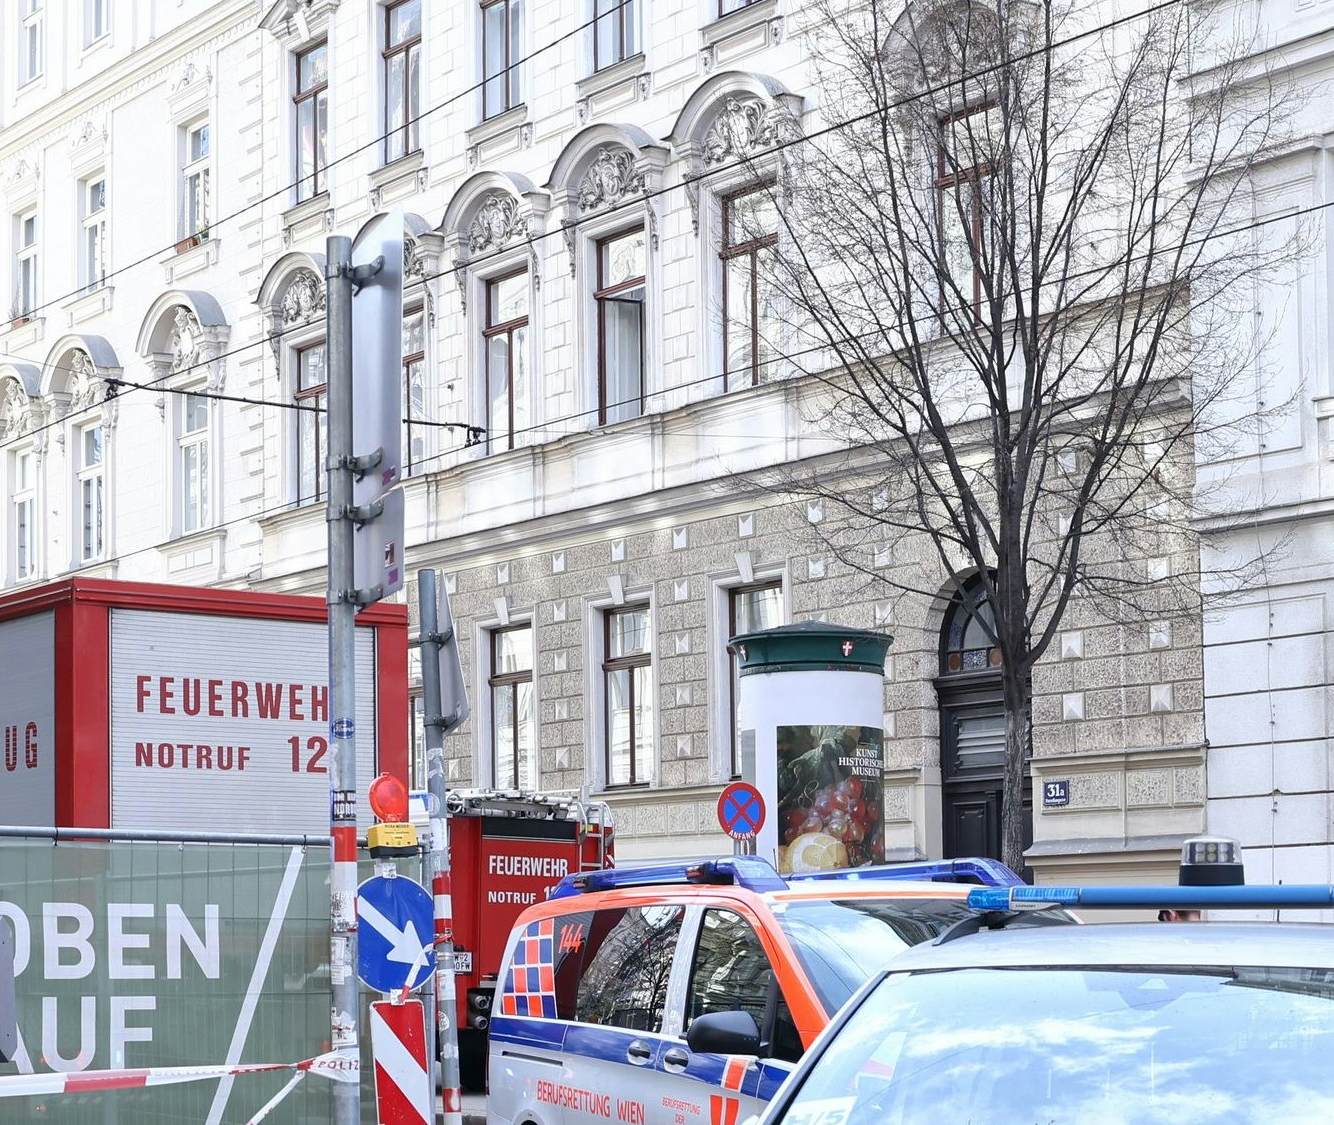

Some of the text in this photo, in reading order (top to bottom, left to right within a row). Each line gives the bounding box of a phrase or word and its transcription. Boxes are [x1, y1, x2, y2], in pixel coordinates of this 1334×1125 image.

[136, 675, 329, 722] FEUERWEH
[135, 735, 329, 774] NOTRUF 12
[855, 748, 879, 759] KUNST
[851, 766, 881, 778] MUSEUM
[1047, 783, 1065, 797] 31a
[728, 829, 756, 841] ANFANG
[488, 855, 568, 878] FEUERWEHR
[488, 890, 537, 905] NOTRUF
[558, 922, 585, 955] 144
[318, 1059, 359, 1071] POLIZ
[536, 1080, 645, 1125] BERUFSRETTUNG WIEN
[662, 1096, 701, 1115] BERUFSRETTUNG
[674, 1115, 685, 1125] DER
